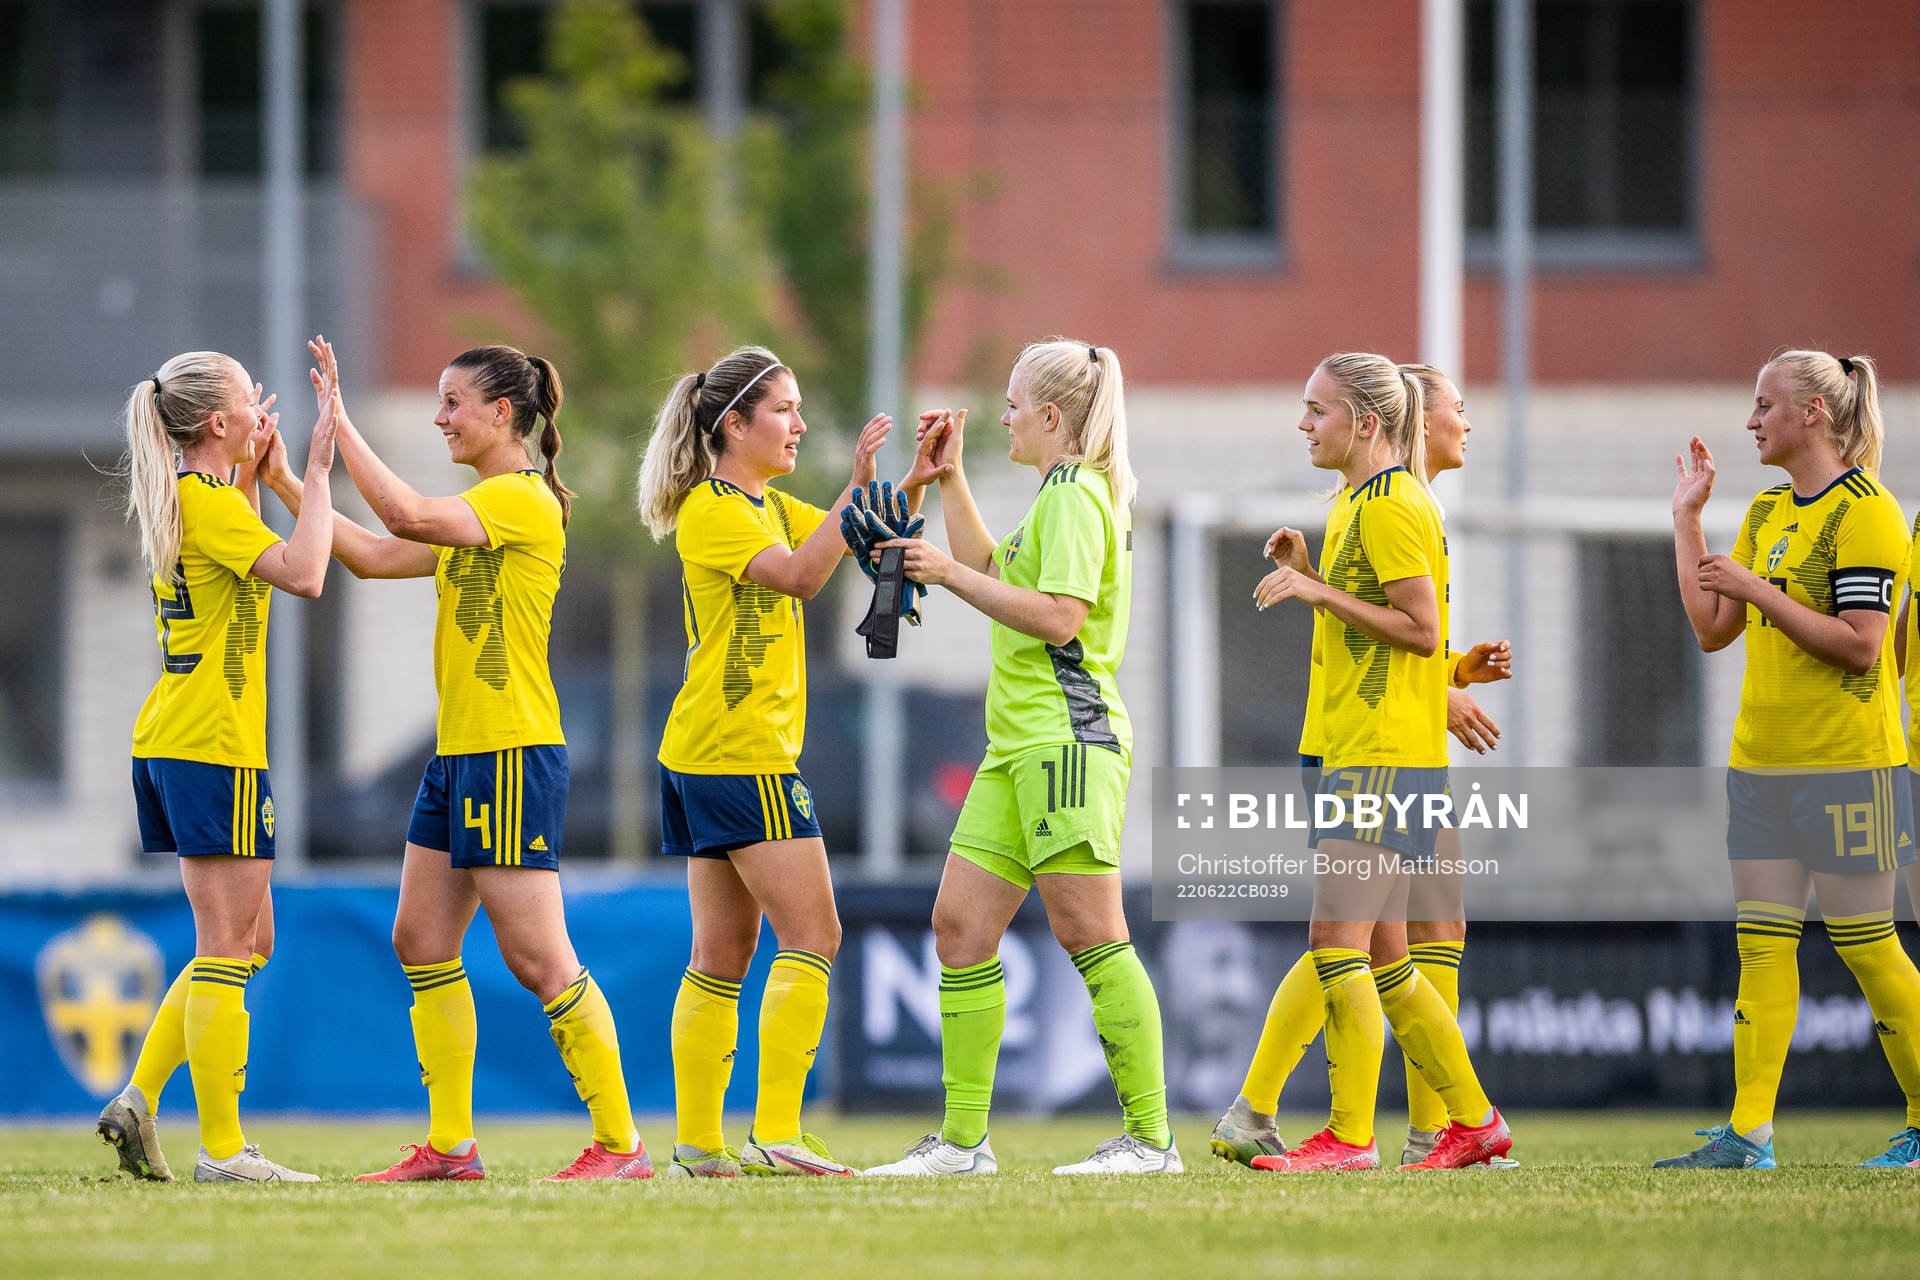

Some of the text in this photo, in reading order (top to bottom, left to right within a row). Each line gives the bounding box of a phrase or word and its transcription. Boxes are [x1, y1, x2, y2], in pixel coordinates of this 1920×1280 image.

[1041, 761, 1056, 813] 1
[464, 797, 492, 849] 4
[1035, 829, 1053, 837] adidas
[1825, 802, 1876, 857] 19
